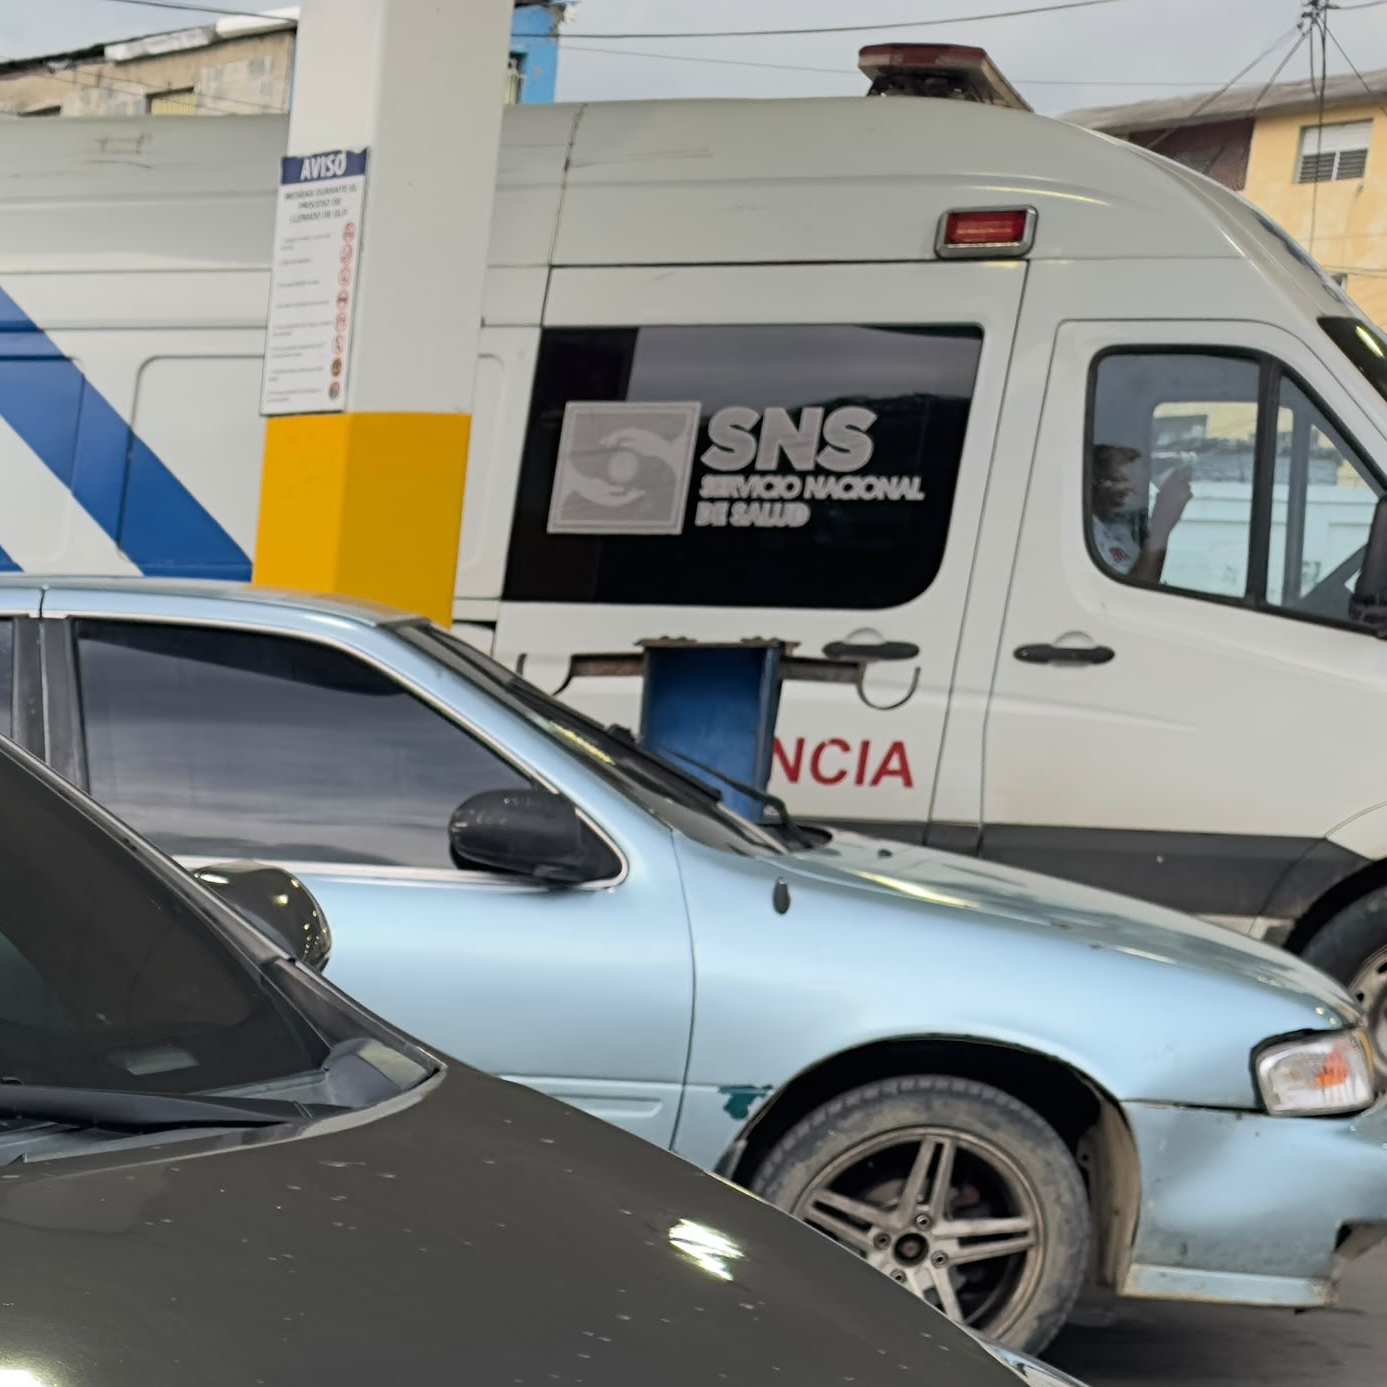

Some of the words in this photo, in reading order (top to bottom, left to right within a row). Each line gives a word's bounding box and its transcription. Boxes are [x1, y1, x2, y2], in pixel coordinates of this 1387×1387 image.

[300, 151, 347, 181] AVISO
[700, 406, 877, 471] SNS
[699, 474, 802, 499] SERVICIO
[803, 475, 926, 501] NACIONAL
[694, 501, 729, 527] DE
[729, 501, 812, 528] SALUD
